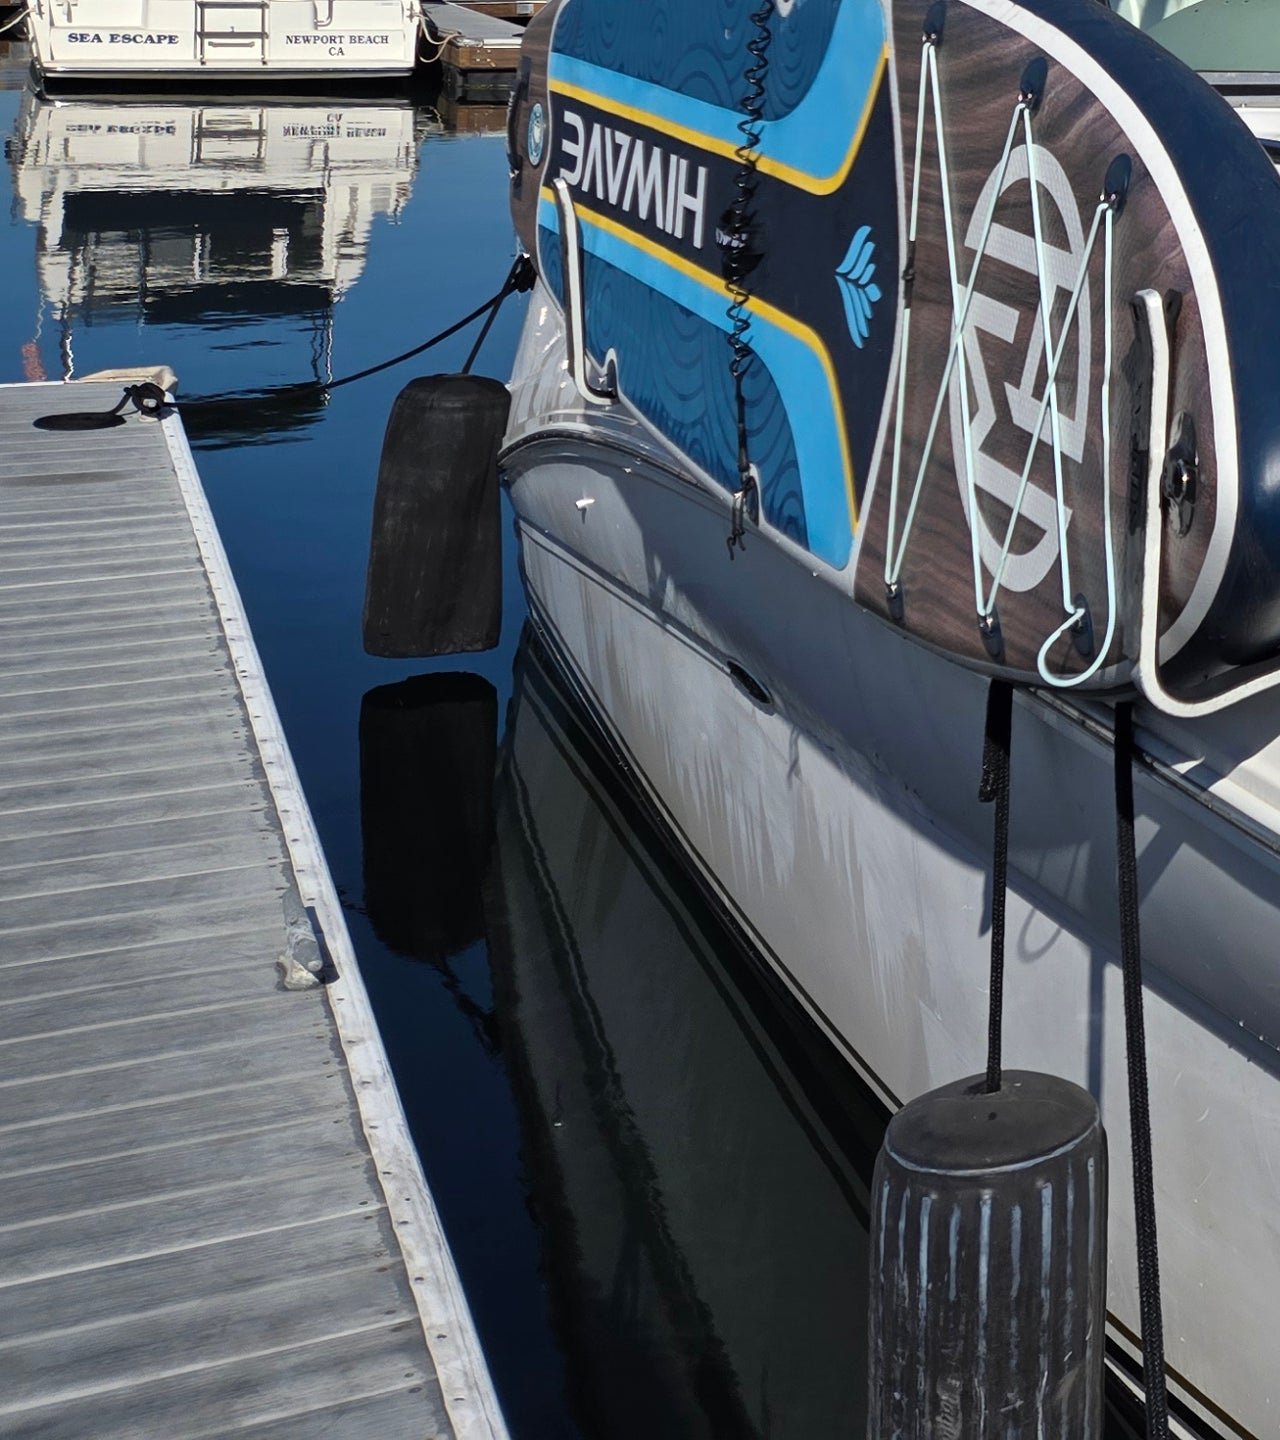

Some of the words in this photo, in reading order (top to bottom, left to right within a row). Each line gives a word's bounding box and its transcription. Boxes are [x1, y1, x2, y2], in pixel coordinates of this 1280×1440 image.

[67, 32, 103, 44] SEA
[109, 33, 179, 45] ESCAPE
[285, 35, 345, 45] NEWPORT
[349, 35, 389, 45] BEACH
[328, 46, 345, 57] CA
[560, 110, 707, 249] HIWAVE
